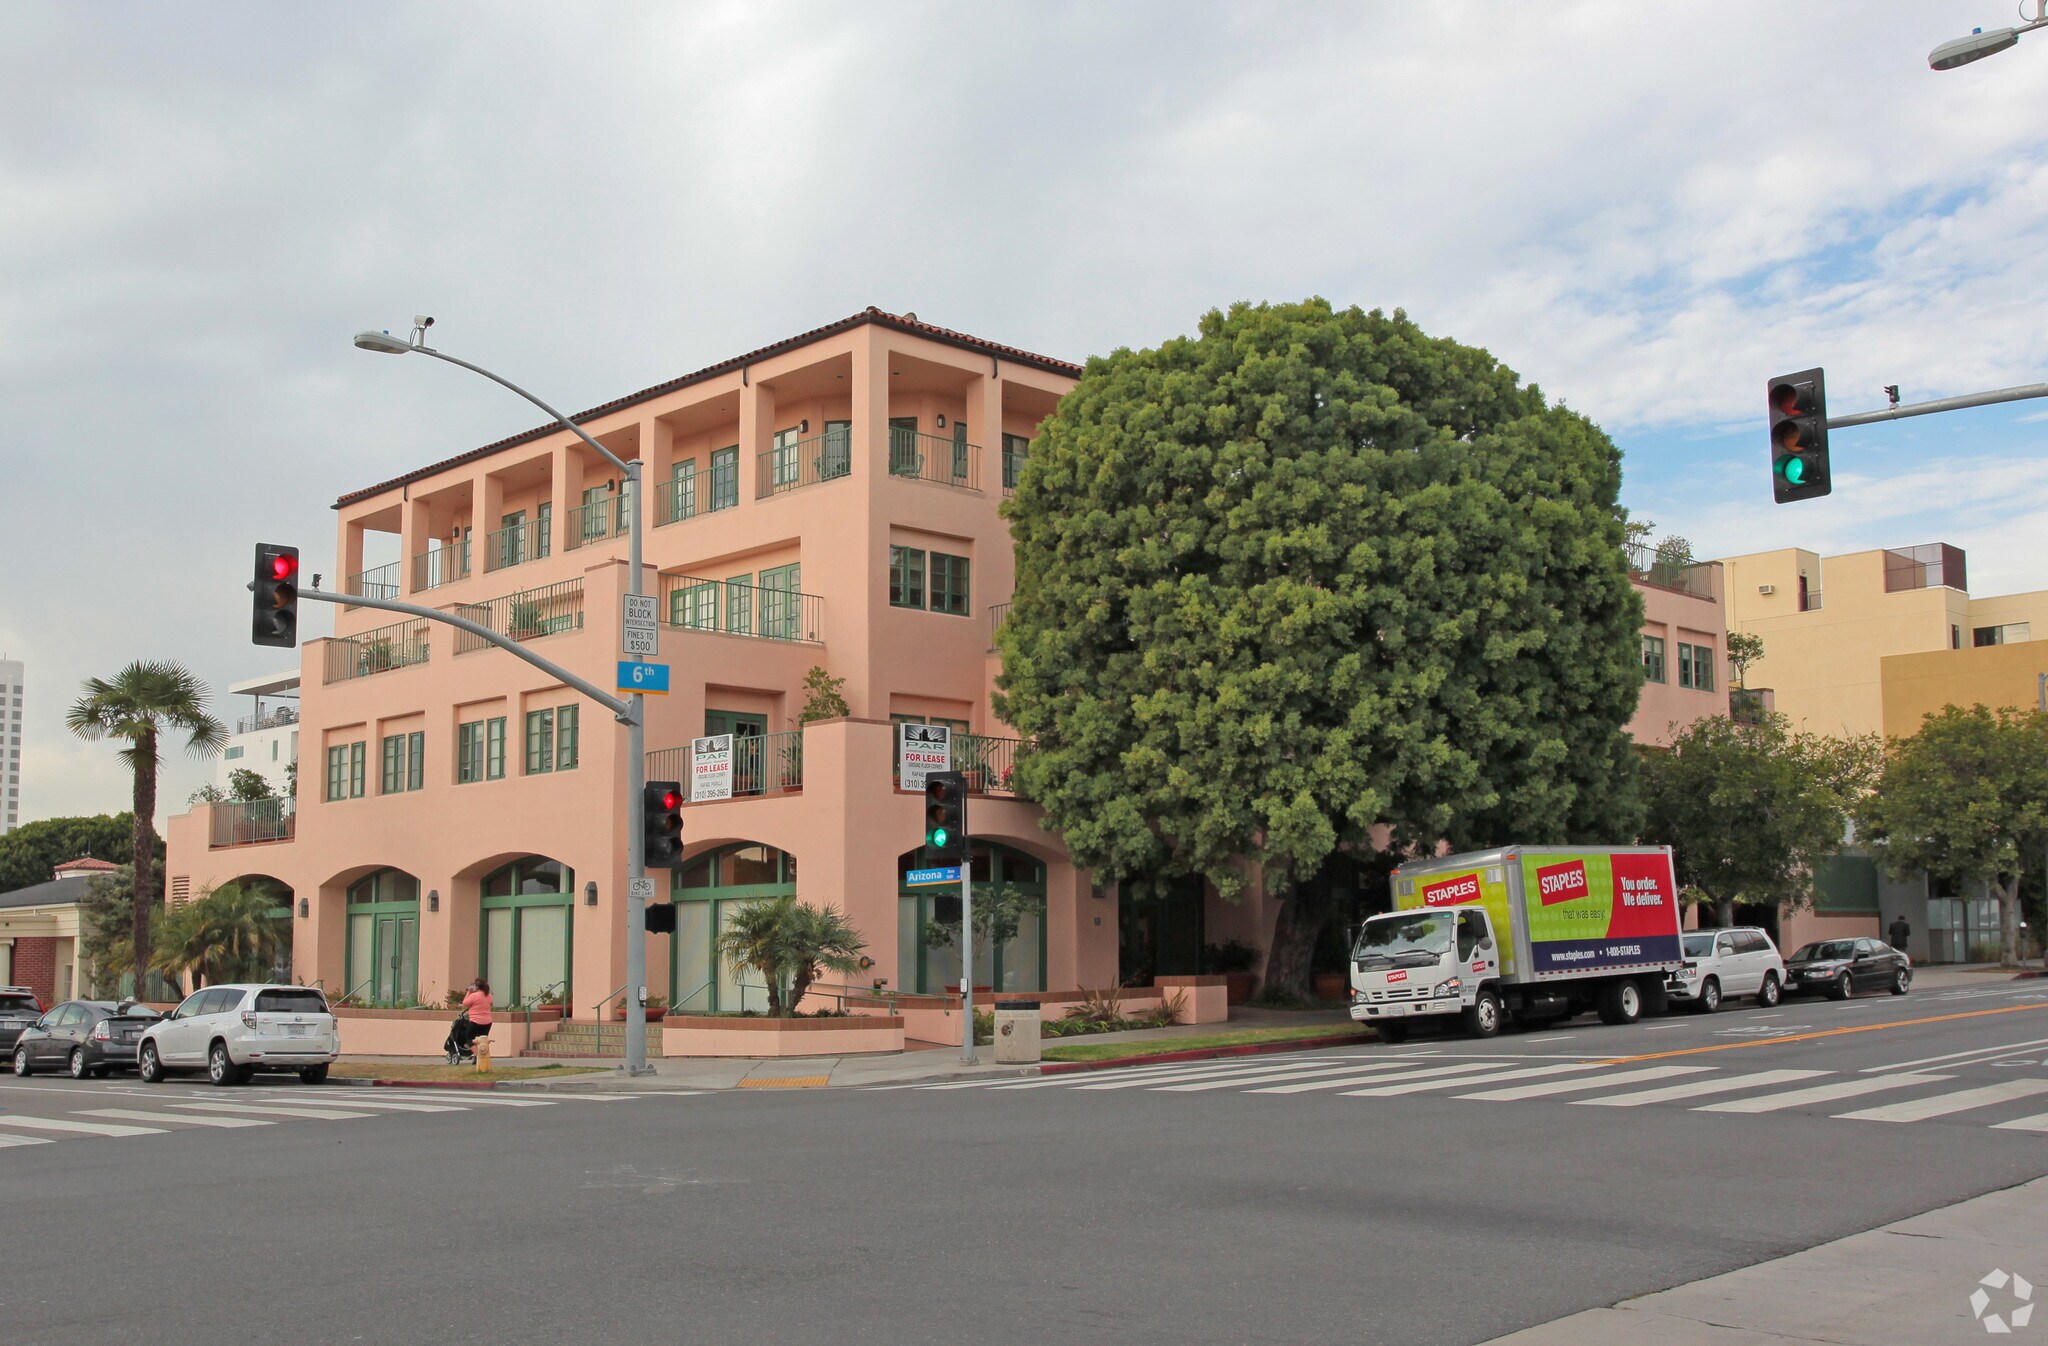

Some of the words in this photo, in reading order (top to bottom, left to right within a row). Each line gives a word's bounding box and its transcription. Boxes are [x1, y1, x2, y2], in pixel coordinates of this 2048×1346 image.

[630, 598, 638, 607] DO
[640, 600, 651, 608] NOT
[628, 608, 652, 619] BLOCK
[625, 619, 656, 627] INTERSECTION
[627, 631, 644, 640] FINES
[646, 632, 654, 640] TO
[630, 640, 651, 651] $500
[632, 666, 655, 683] 6th
[905, 742, 945, 750] PAR
[696, 752, 728, 761] PAR
[905, 753, 921, 761] FOR
[922, 754, 946, 763] LEASE
[696, 766, 708, 774] FOR
[709, 763, 729, 773] LEASE
[904, 779, 919, 788] (310)
[695, 790, 707, 800] (310)
[908, 871, 942, 881] Arizona
[1541, 869, 1584, 894] STAPLES
[1621, 876, 1635, 891] You
[1636, 876, 1658, 890] order.
[1427, 881, 1476, 903] STAPLES
[1622, 892, 1635, 906] We
[1636, 892, 1663, 906] deliver.
[1562, 909, 1575, 920] that
[1576, 911, 1589, 919] was
[1551, 950, 1595, 962] www.staples.com
[1605, 944, 1641, 957] 1-800-STAPLES
[1387, 972, 1406, 981] STAPLES
